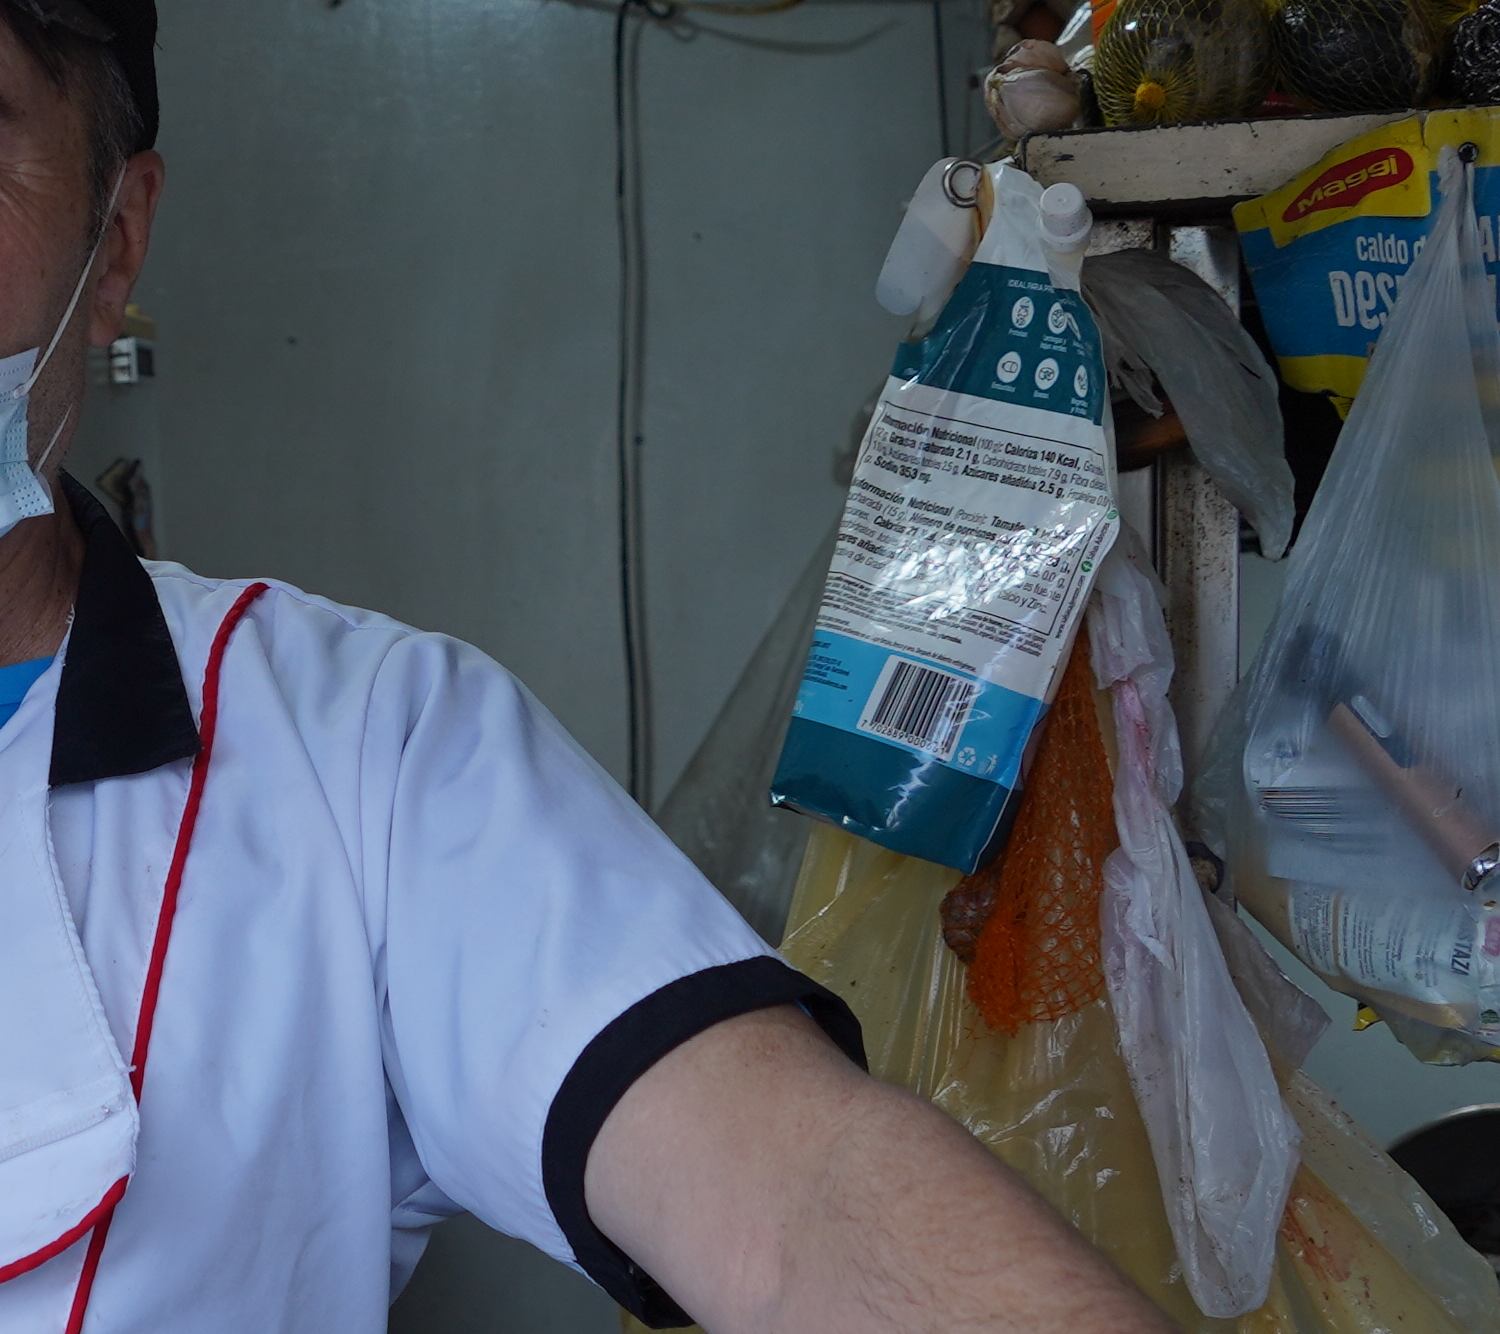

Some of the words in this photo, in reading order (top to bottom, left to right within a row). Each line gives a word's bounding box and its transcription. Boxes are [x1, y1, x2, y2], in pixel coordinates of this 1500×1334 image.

[1296, 154, 1399, 213] Maggi
[1355, 233, 1408, 265] caldo
[888, 429, 916, 449] Grasa
[955, 447, 972, 463] 2.1
[931, 423, 978, 448] Nutricional
[1037, 479, 1055, 496] 2.5
[906, 495, 955, 518] Nutricional
